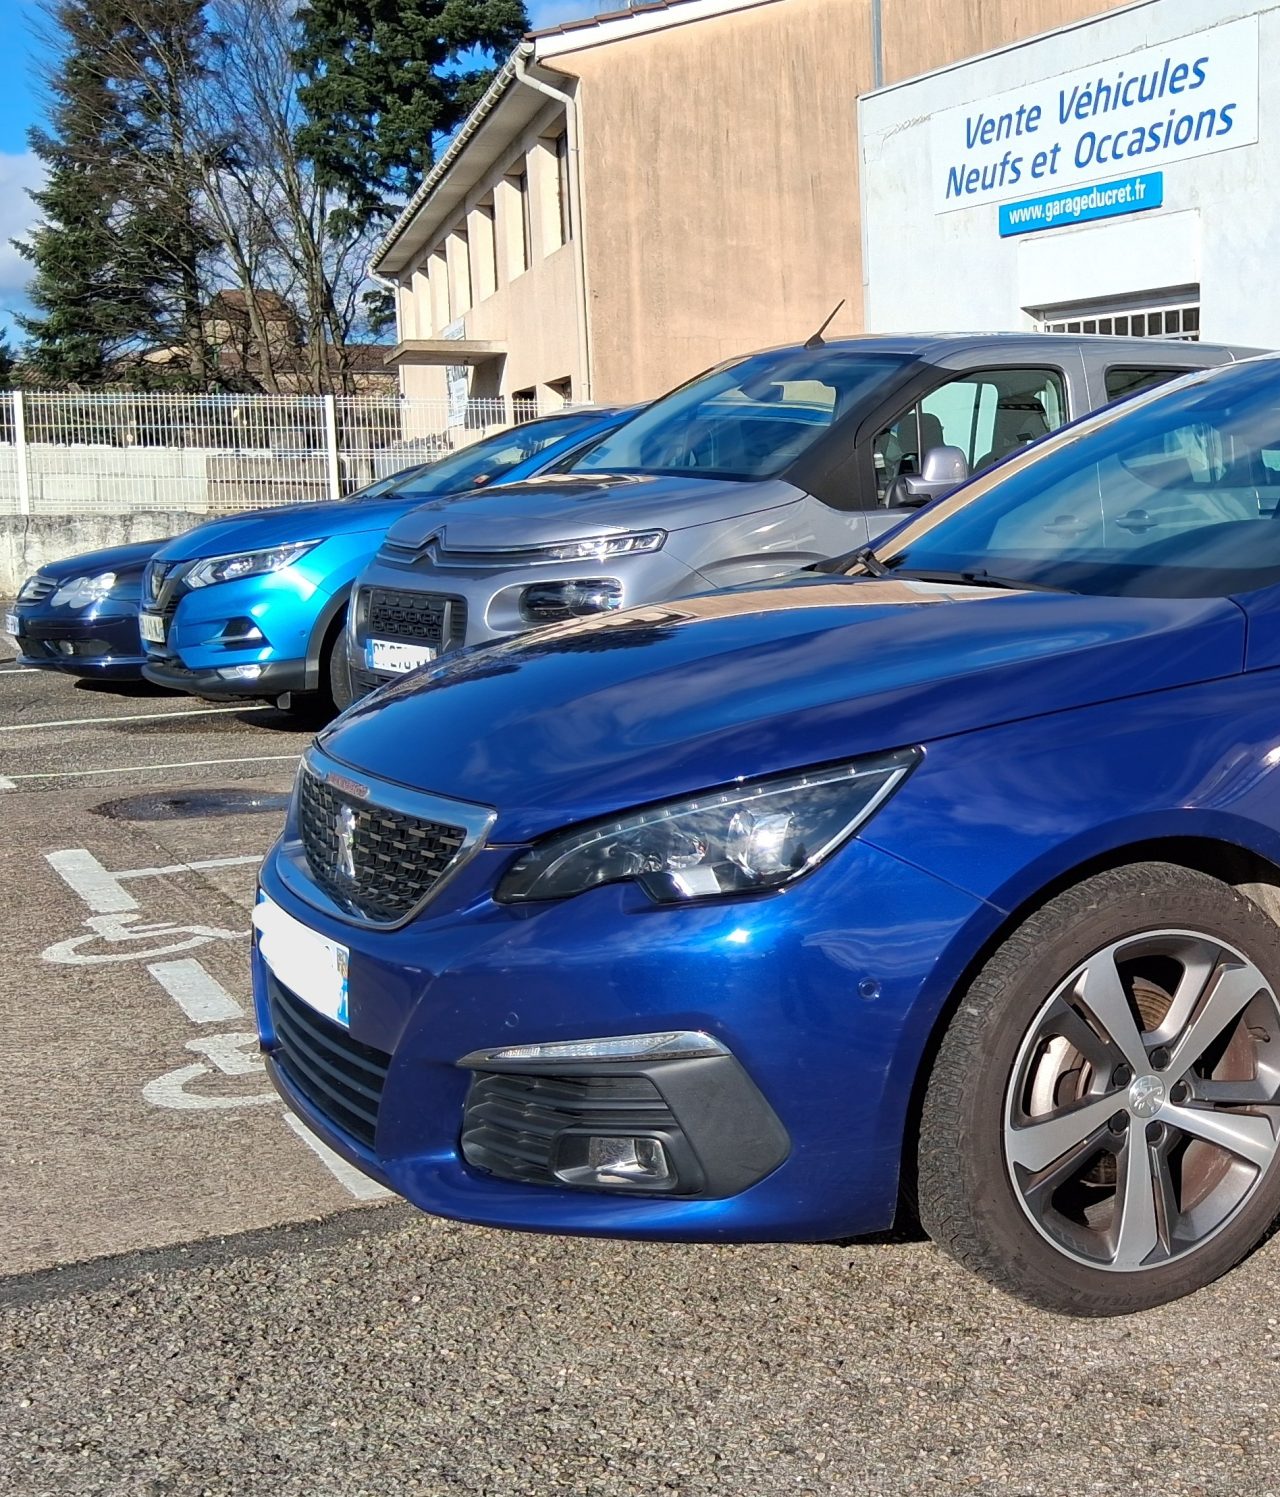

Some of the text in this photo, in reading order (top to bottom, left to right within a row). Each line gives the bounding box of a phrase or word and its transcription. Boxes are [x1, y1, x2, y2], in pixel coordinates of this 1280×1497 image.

[966, 57, 1210, 149] Vente Véhicules
[946, 103, 1237, 199] Neufs et Occasions
[1009, 180, 1147, 224] www.garageducret.fr
